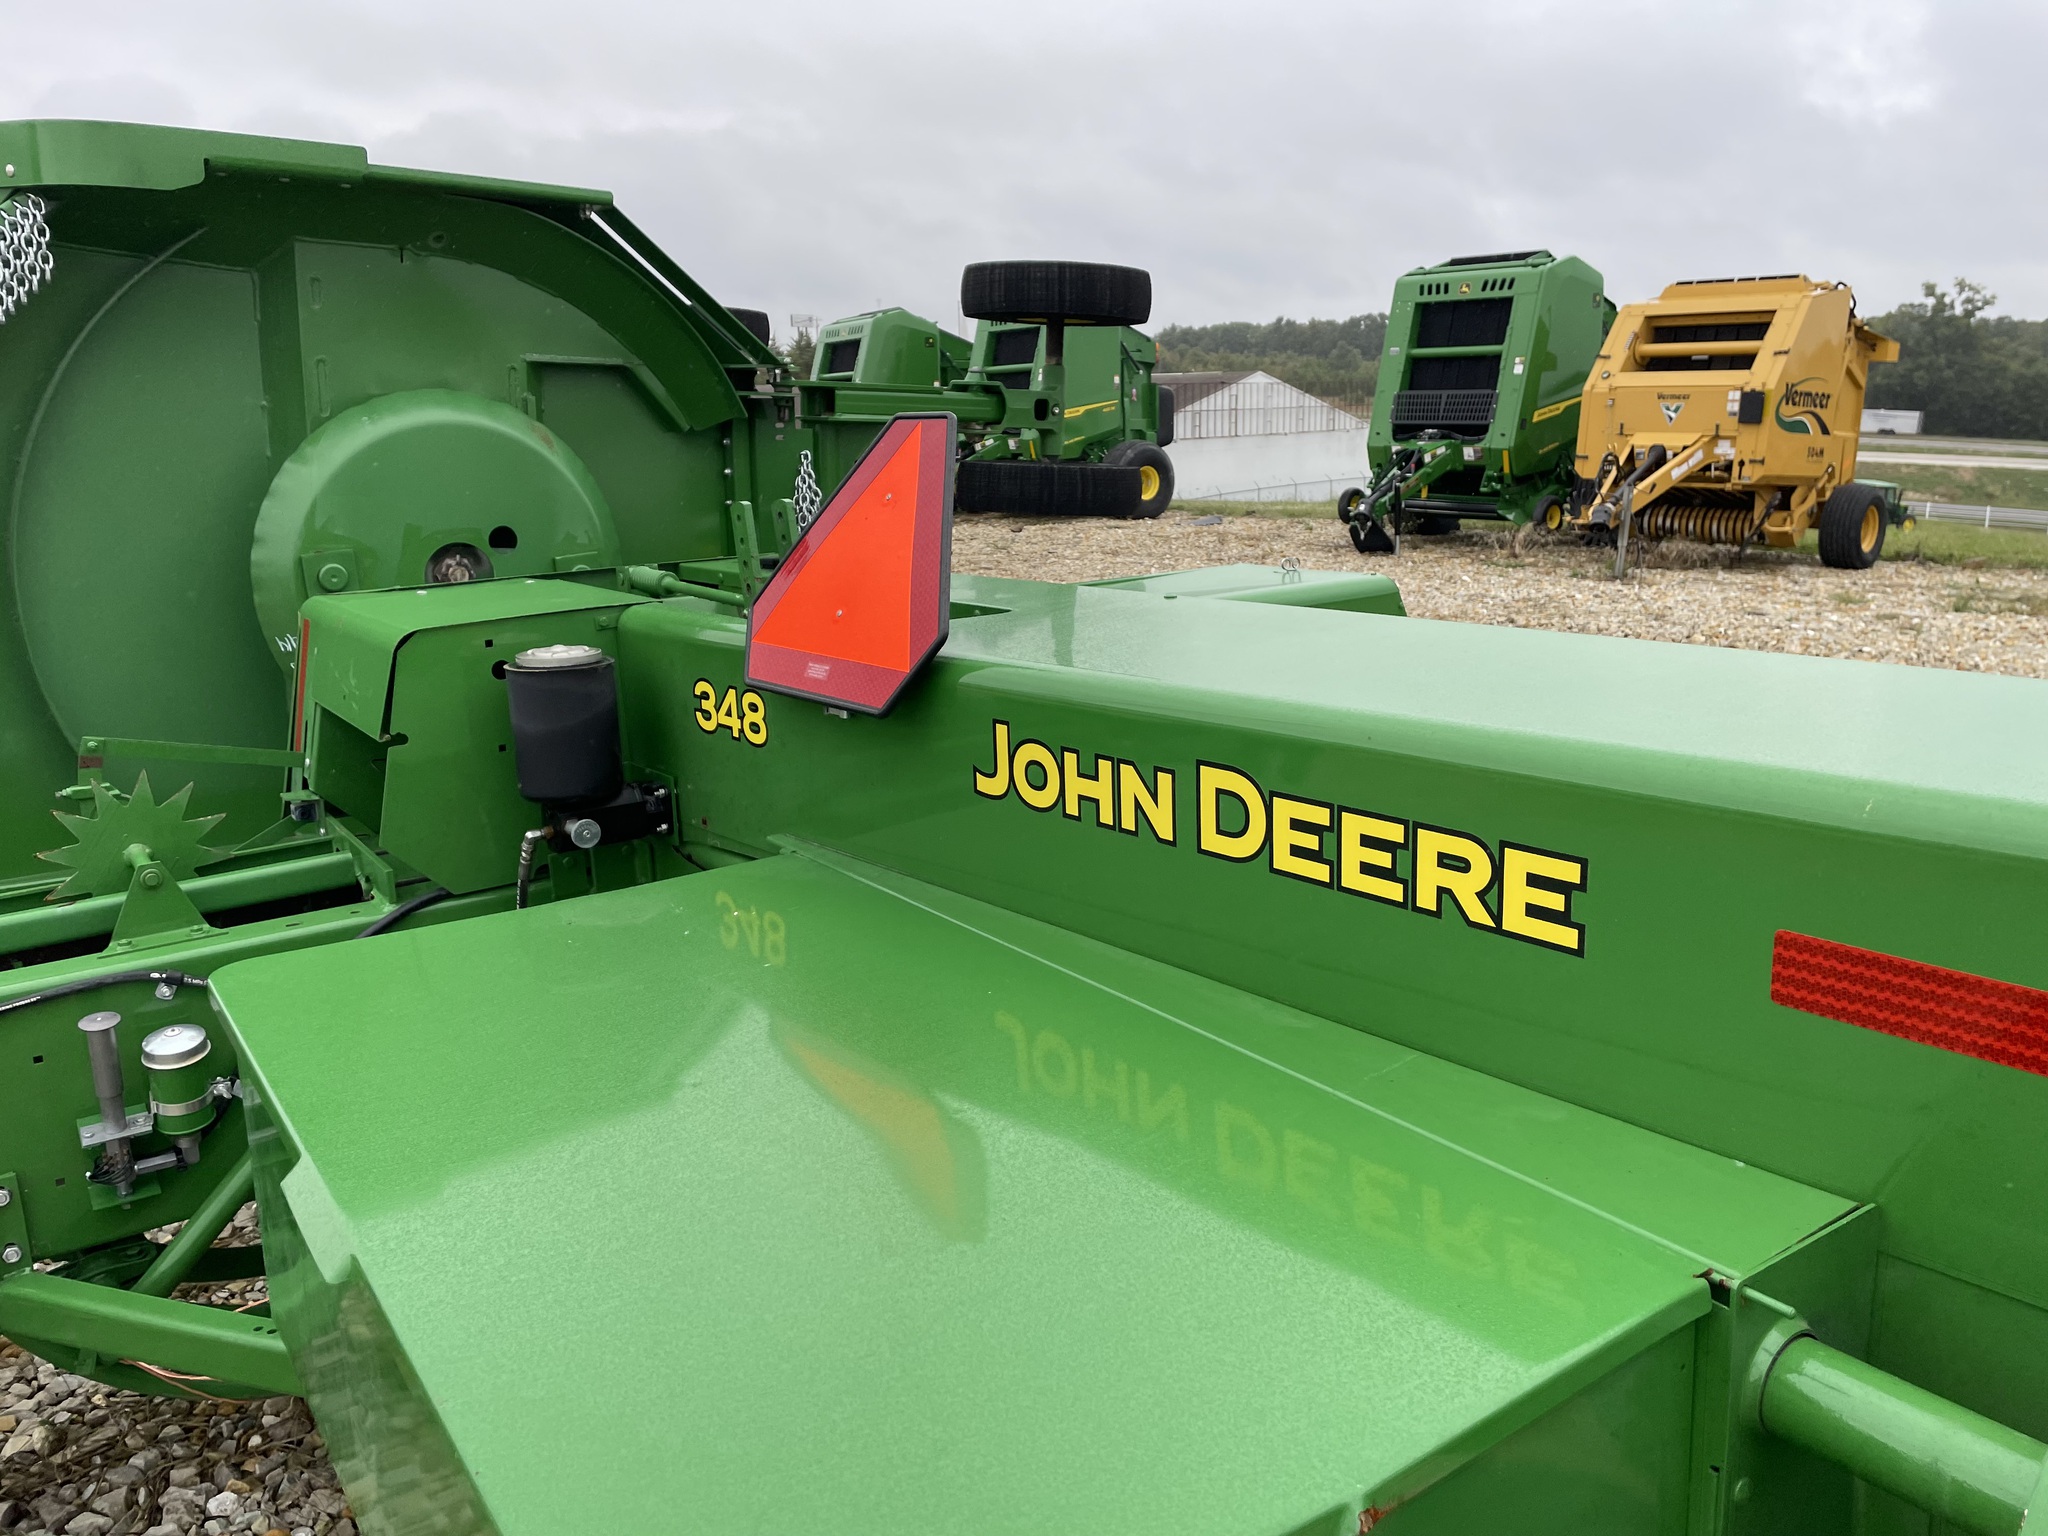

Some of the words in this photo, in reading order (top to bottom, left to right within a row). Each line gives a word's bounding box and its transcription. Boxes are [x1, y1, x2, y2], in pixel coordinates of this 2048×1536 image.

[1656, 392, 1691, 400] Vermeer
[1784, 382, 1832, 409] Vermeer
[692, 678, 768, 748] 348
[973, 719, 1177, 847] JOHN
[1196, 759, 1589, 958] DEERE
